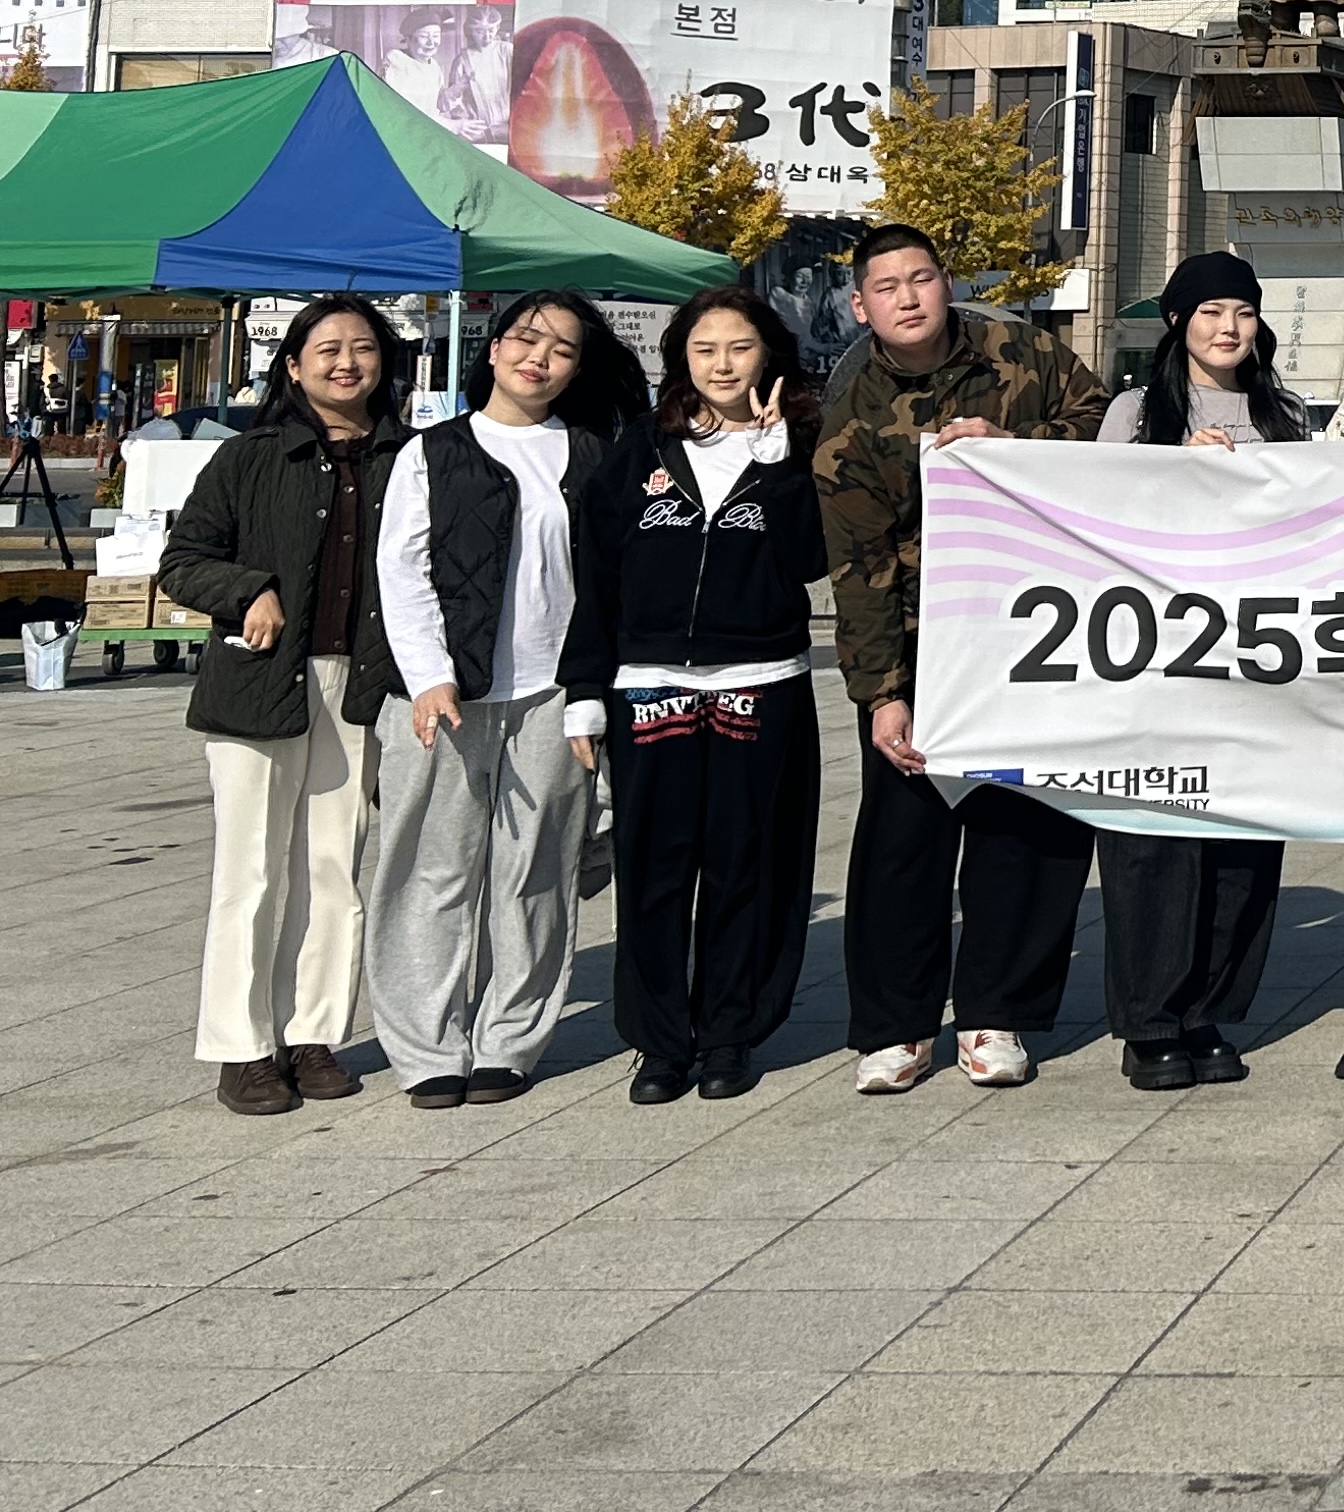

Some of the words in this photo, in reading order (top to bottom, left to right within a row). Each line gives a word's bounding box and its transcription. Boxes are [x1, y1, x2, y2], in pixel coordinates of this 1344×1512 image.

[675, 2, 738, 36] 본점
[785, 163, 870, 184] 삼대옥
[251, 326, 278, 337] 1968
[462, 326, 484, 337] 968
[639, 499, 700, 530] Bad
